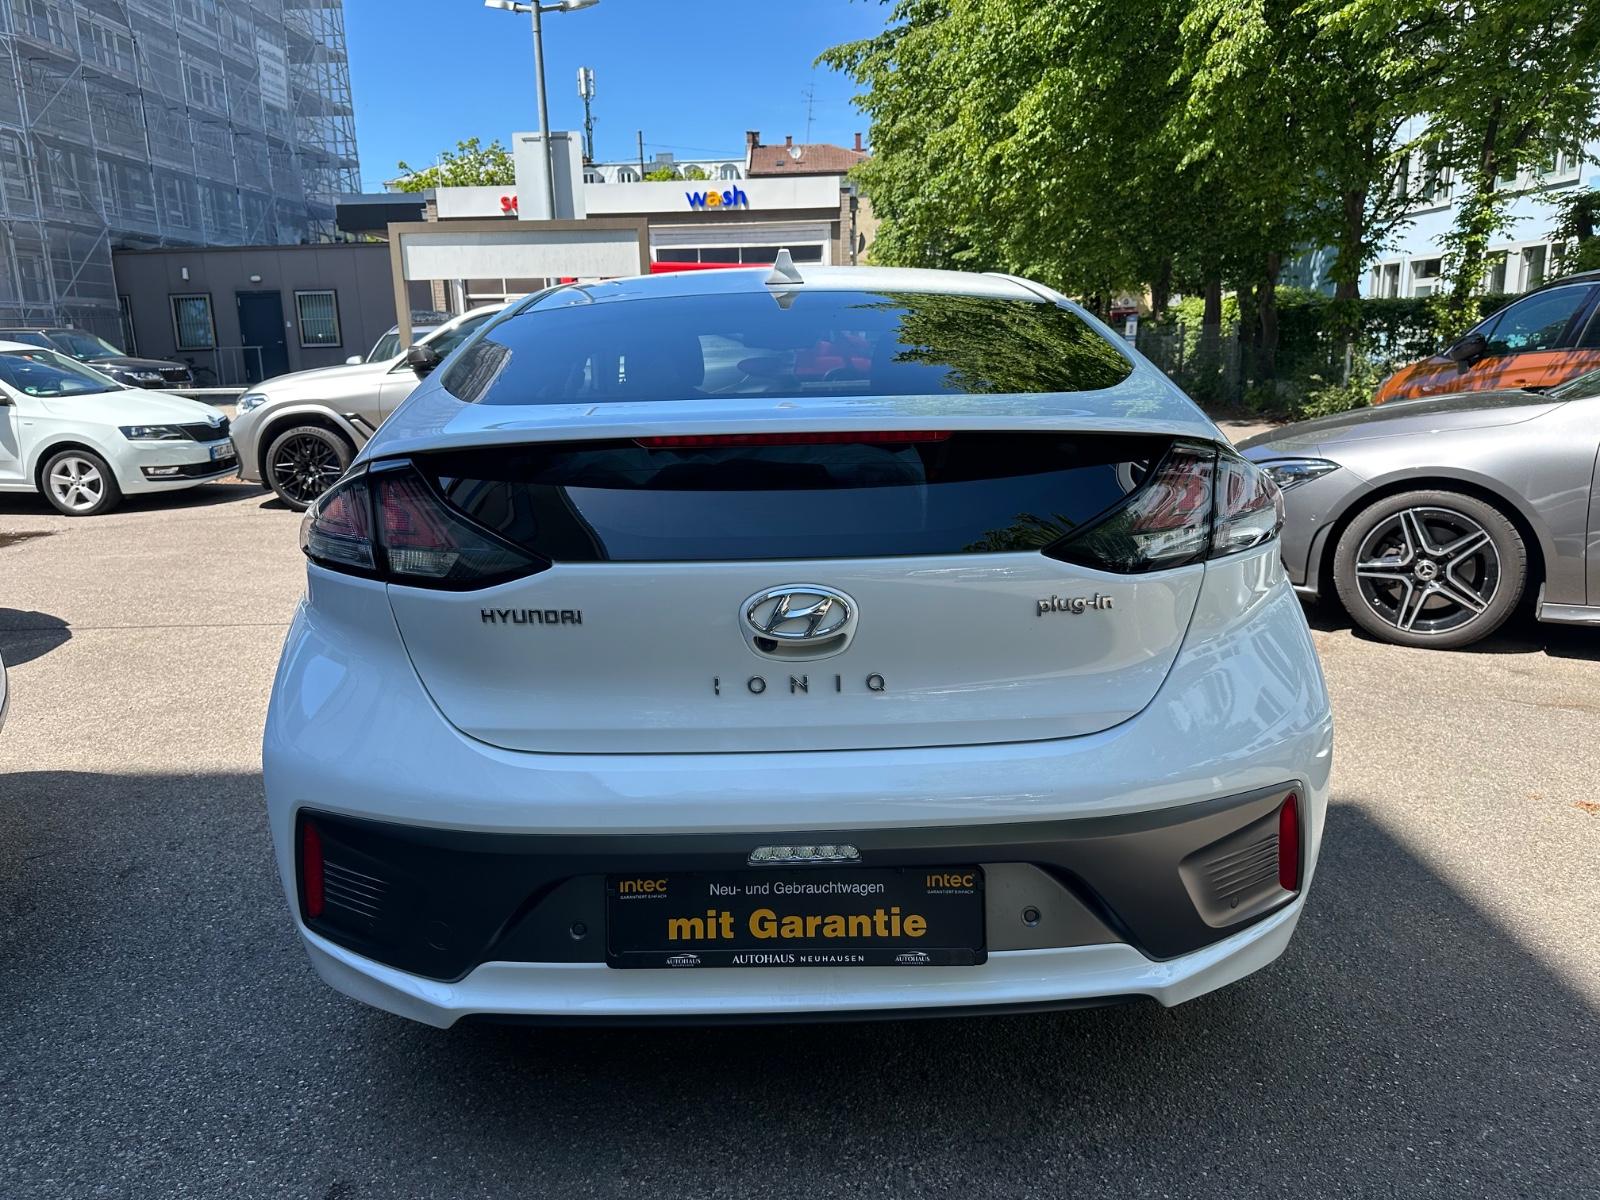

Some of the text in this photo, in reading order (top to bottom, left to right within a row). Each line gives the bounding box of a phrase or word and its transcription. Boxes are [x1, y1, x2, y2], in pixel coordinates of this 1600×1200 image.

[686, 185, 747, 208] wash
[1036, 594, 1113, 617] plug-in
[481, 607, 583, 626] HYUNDAI
[713, 671, 888, 695] IONIQ
[619, 878, 668, 893] intec
[709, 880, 885, 897] Neu- und Gebrauchtwagen
[926, 873, 974, 888] intec
[668, 907, 927, 940] mit Garantie
[665, 957, 701, 965] AUTOHAUS
[732, 953, 865, 964] AUTOHAUS NEUHAUSEN
[895, 955, 931, 963] AUTOHAUS
